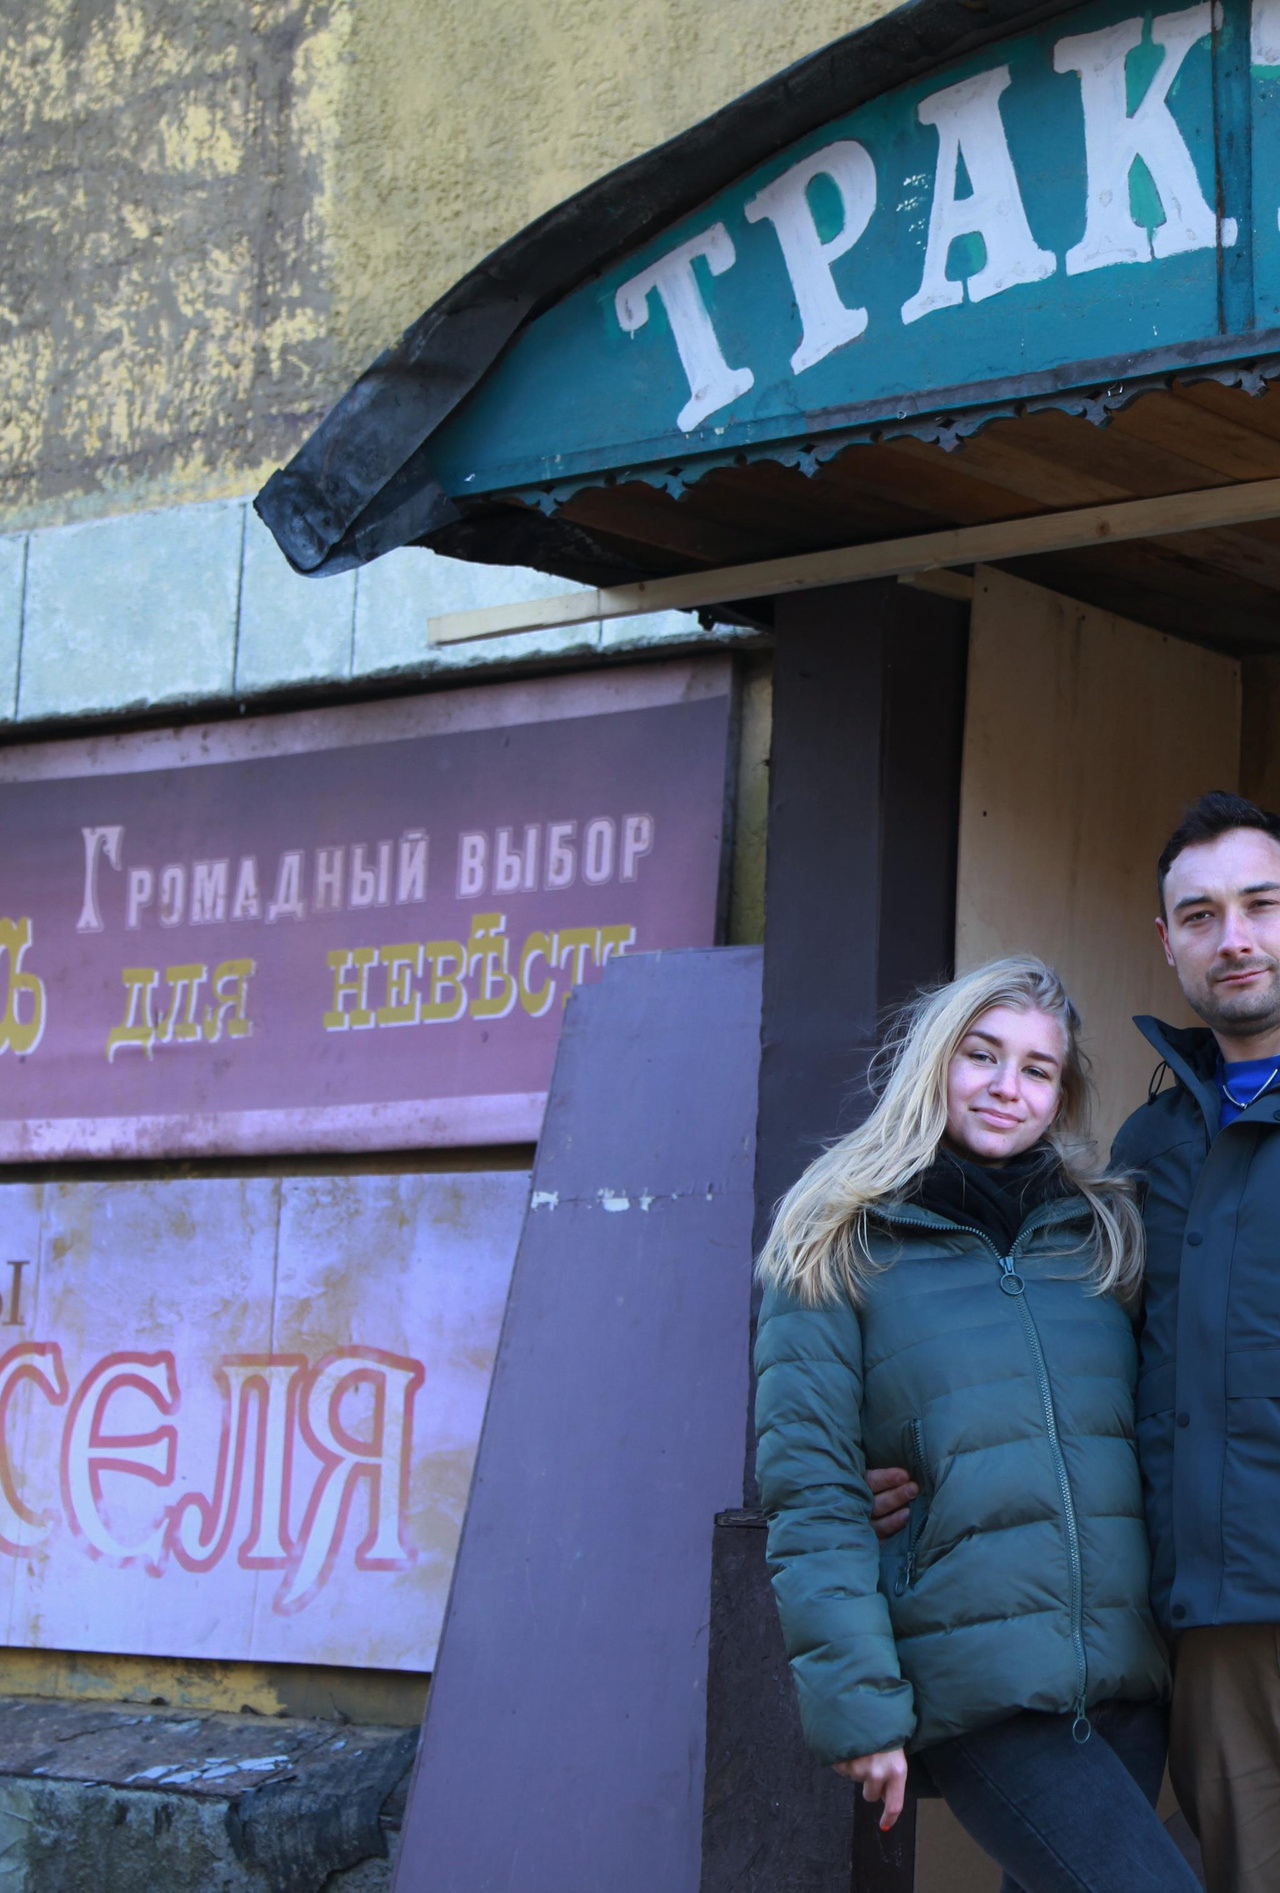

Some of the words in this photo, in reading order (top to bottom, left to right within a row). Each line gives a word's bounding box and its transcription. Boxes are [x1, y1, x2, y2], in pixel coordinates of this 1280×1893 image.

[76, 825, 430, 933] ГРОМАДНЫЙ
[456, 813, 655, 899] ВЫБОР
[105, 958, 257, 1063] ДЛЯ
